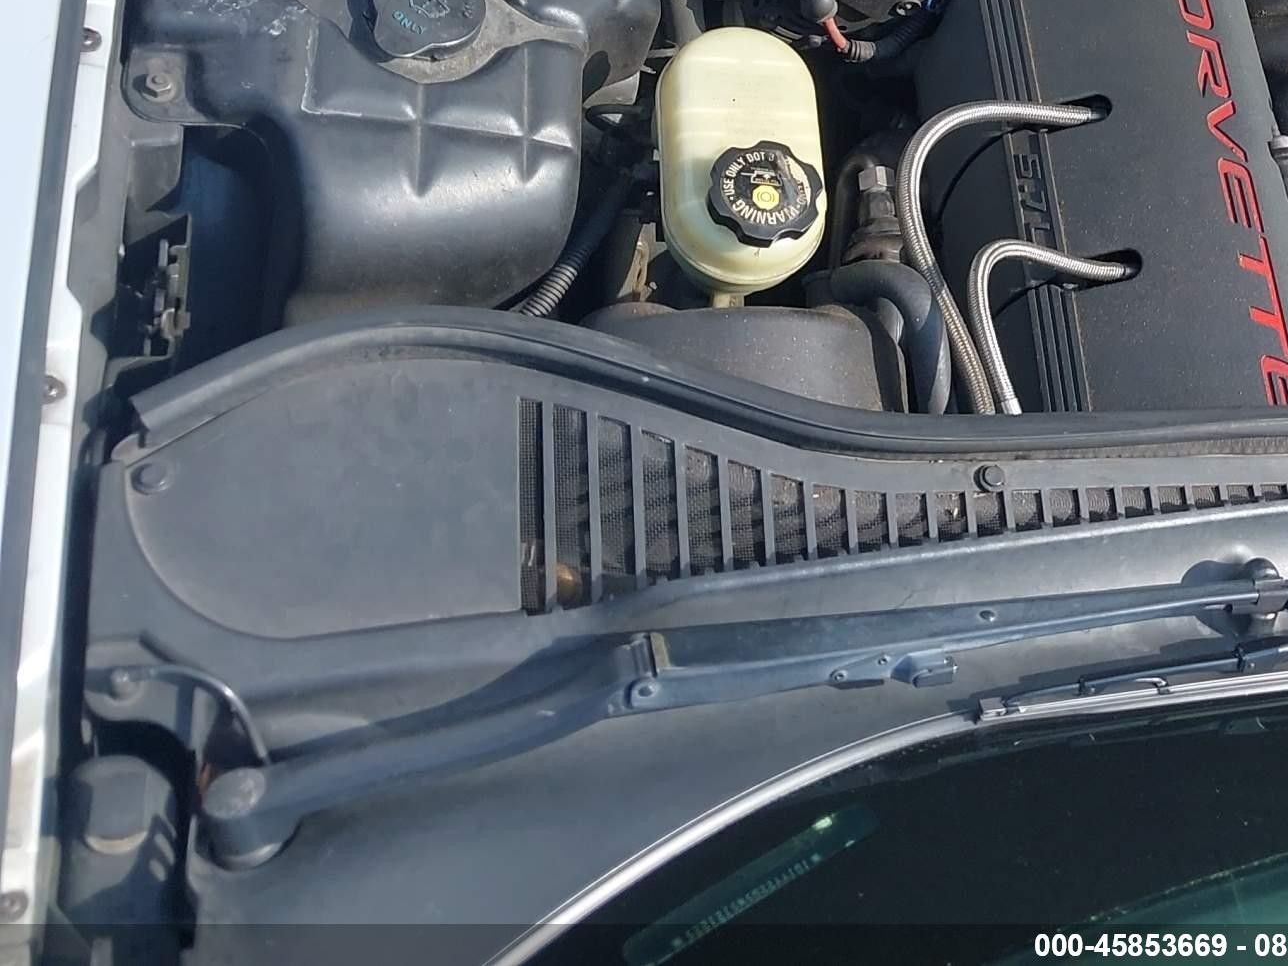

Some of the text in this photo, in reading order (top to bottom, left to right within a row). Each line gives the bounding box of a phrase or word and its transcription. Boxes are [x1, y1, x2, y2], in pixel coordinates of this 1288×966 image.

[392, 9, 427, 35] ONLY
[725, 156, 747, 178] ONLY
[745, 151, 765, 163] DOT
[723, 177, 735, 196] USE
[1012, 152, 1052, 245] 5.7L
[732, 198, 800, 225] WARNING
